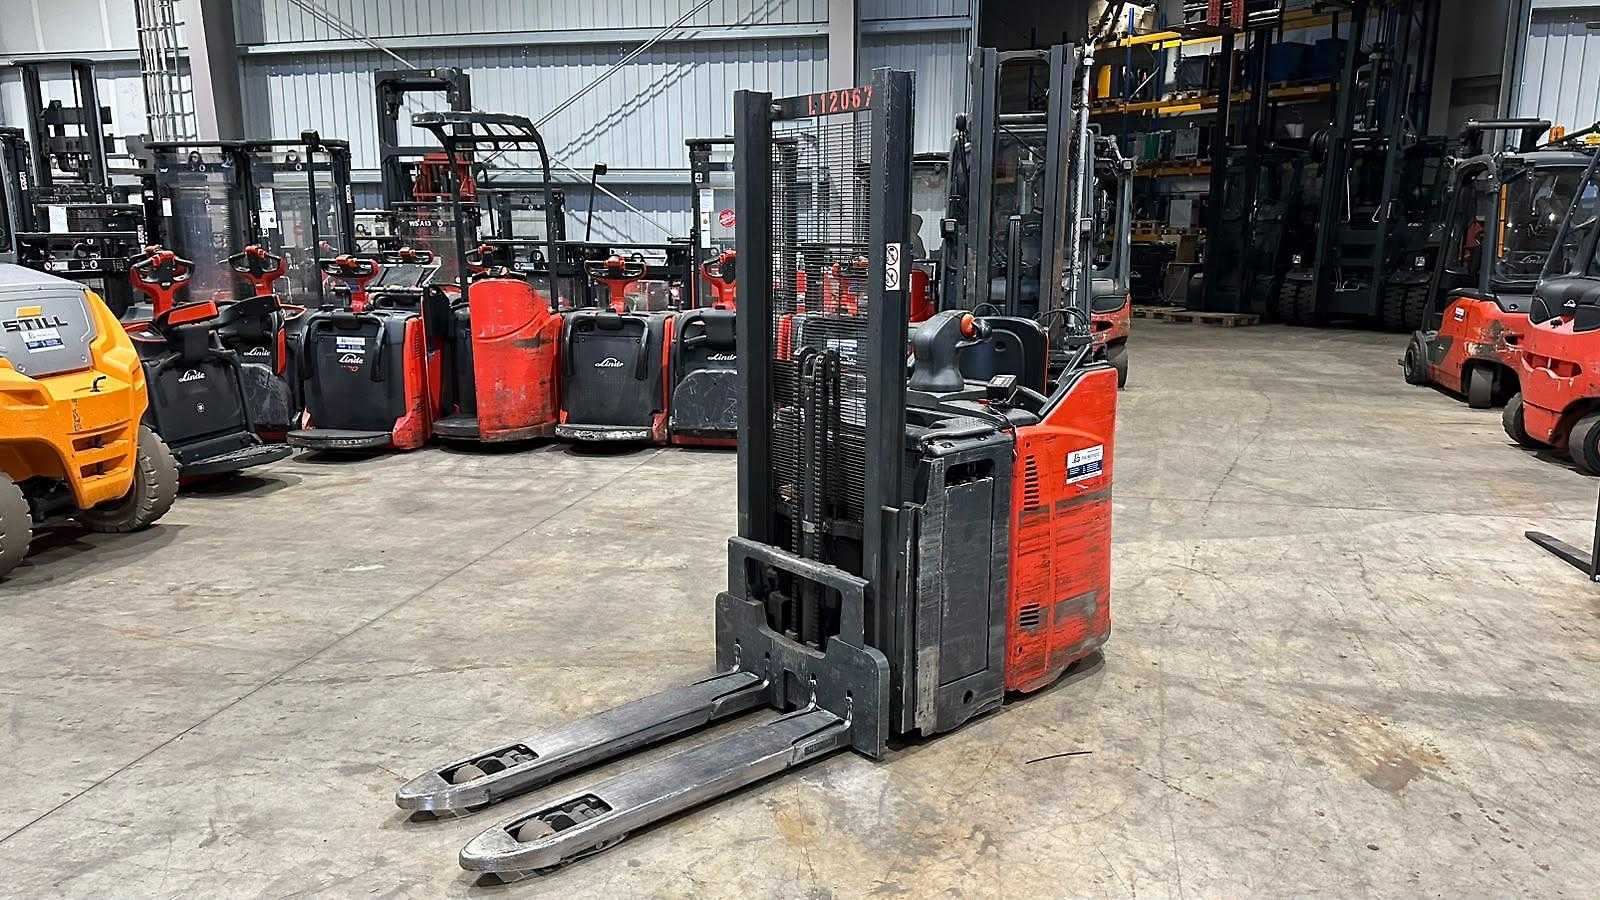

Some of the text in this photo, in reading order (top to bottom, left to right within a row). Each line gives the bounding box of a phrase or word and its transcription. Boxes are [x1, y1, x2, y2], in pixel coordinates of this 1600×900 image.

[2, 316, 69, 332] STILL
[244, 347, 270, 356] Linde
[339, 353, 364, 364] Linde
[178, 369, 205, 383] Linde
